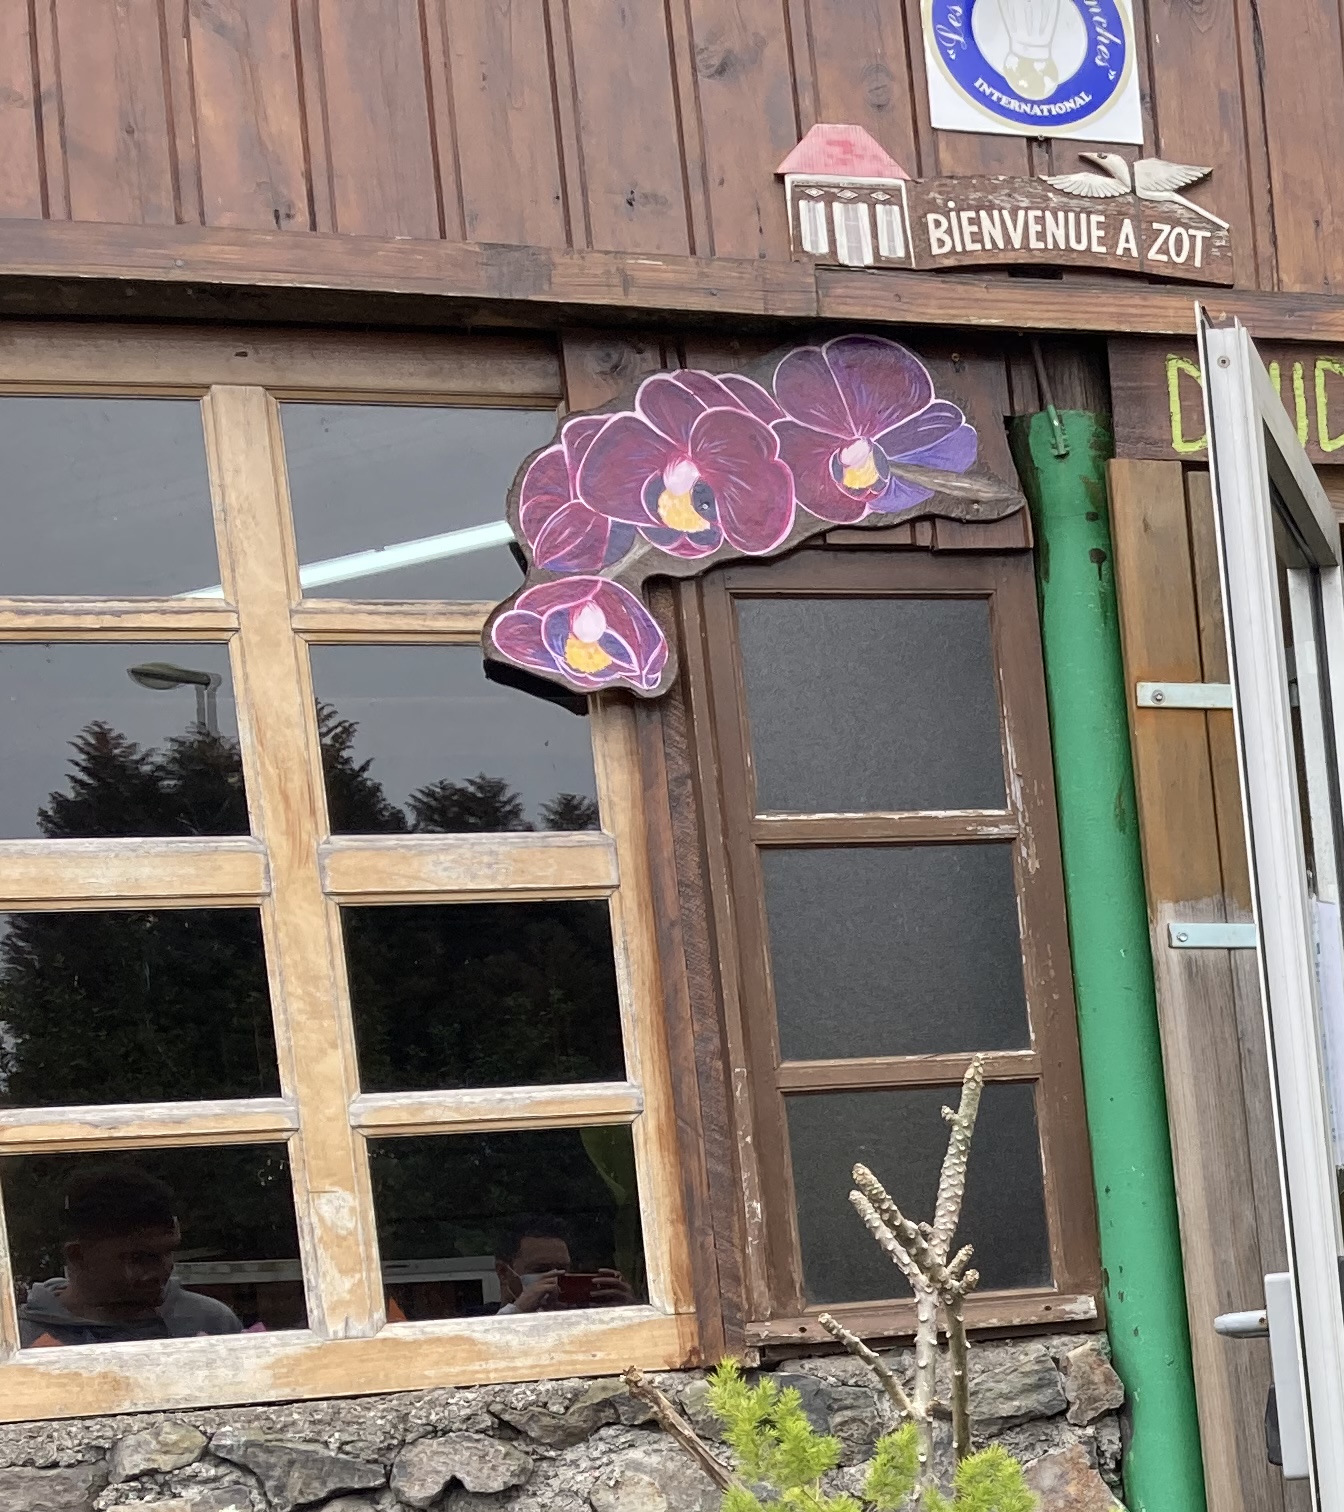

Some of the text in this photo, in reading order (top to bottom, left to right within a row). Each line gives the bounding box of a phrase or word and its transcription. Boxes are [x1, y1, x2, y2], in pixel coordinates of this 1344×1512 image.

[974, 77, 1093, 116] INTERNATIONAL
[926, 201, 1212, 268] BIENVENUE A ZOT
